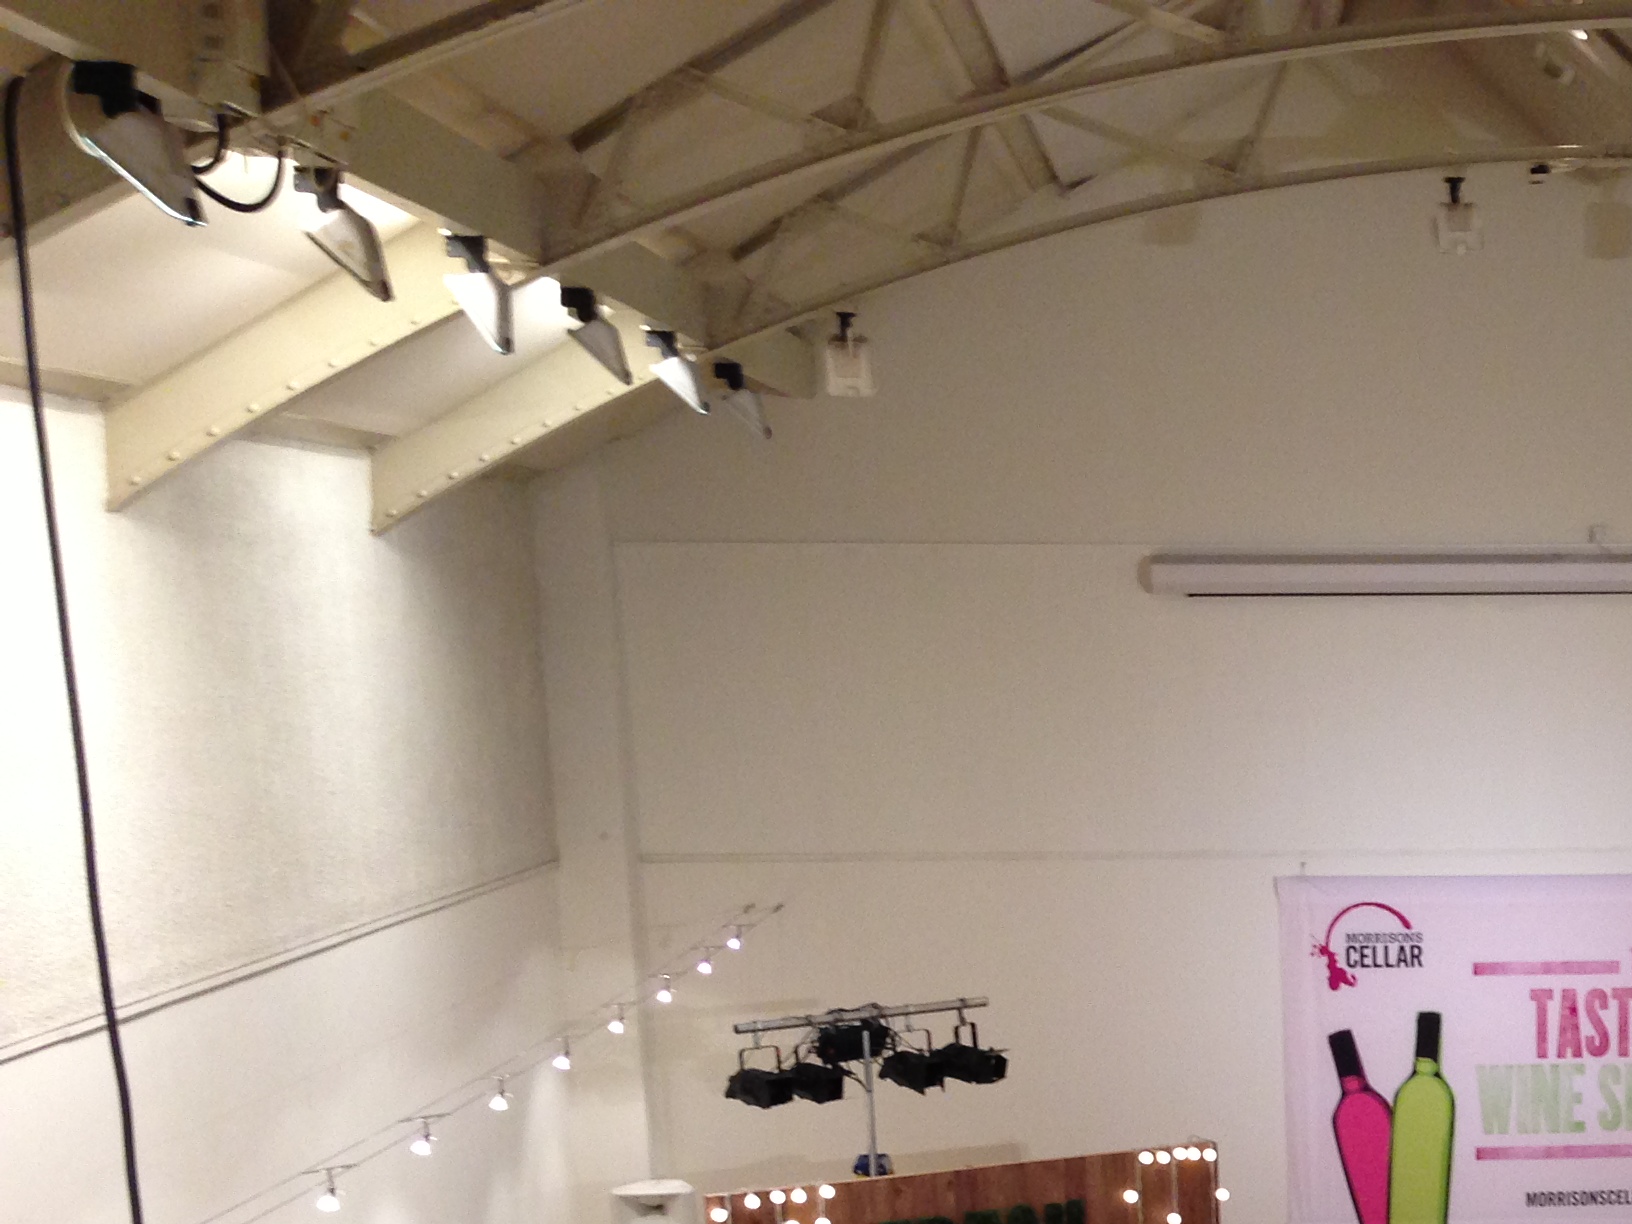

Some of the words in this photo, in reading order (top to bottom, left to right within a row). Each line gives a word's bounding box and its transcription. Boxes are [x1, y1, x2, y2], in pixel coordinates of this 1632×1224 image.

[1345, 932, 1424, 944] MORRISONS
[1345, 945, 1423, 968] CELLAR
[1475, 1063, 1586, 1135] WINE
